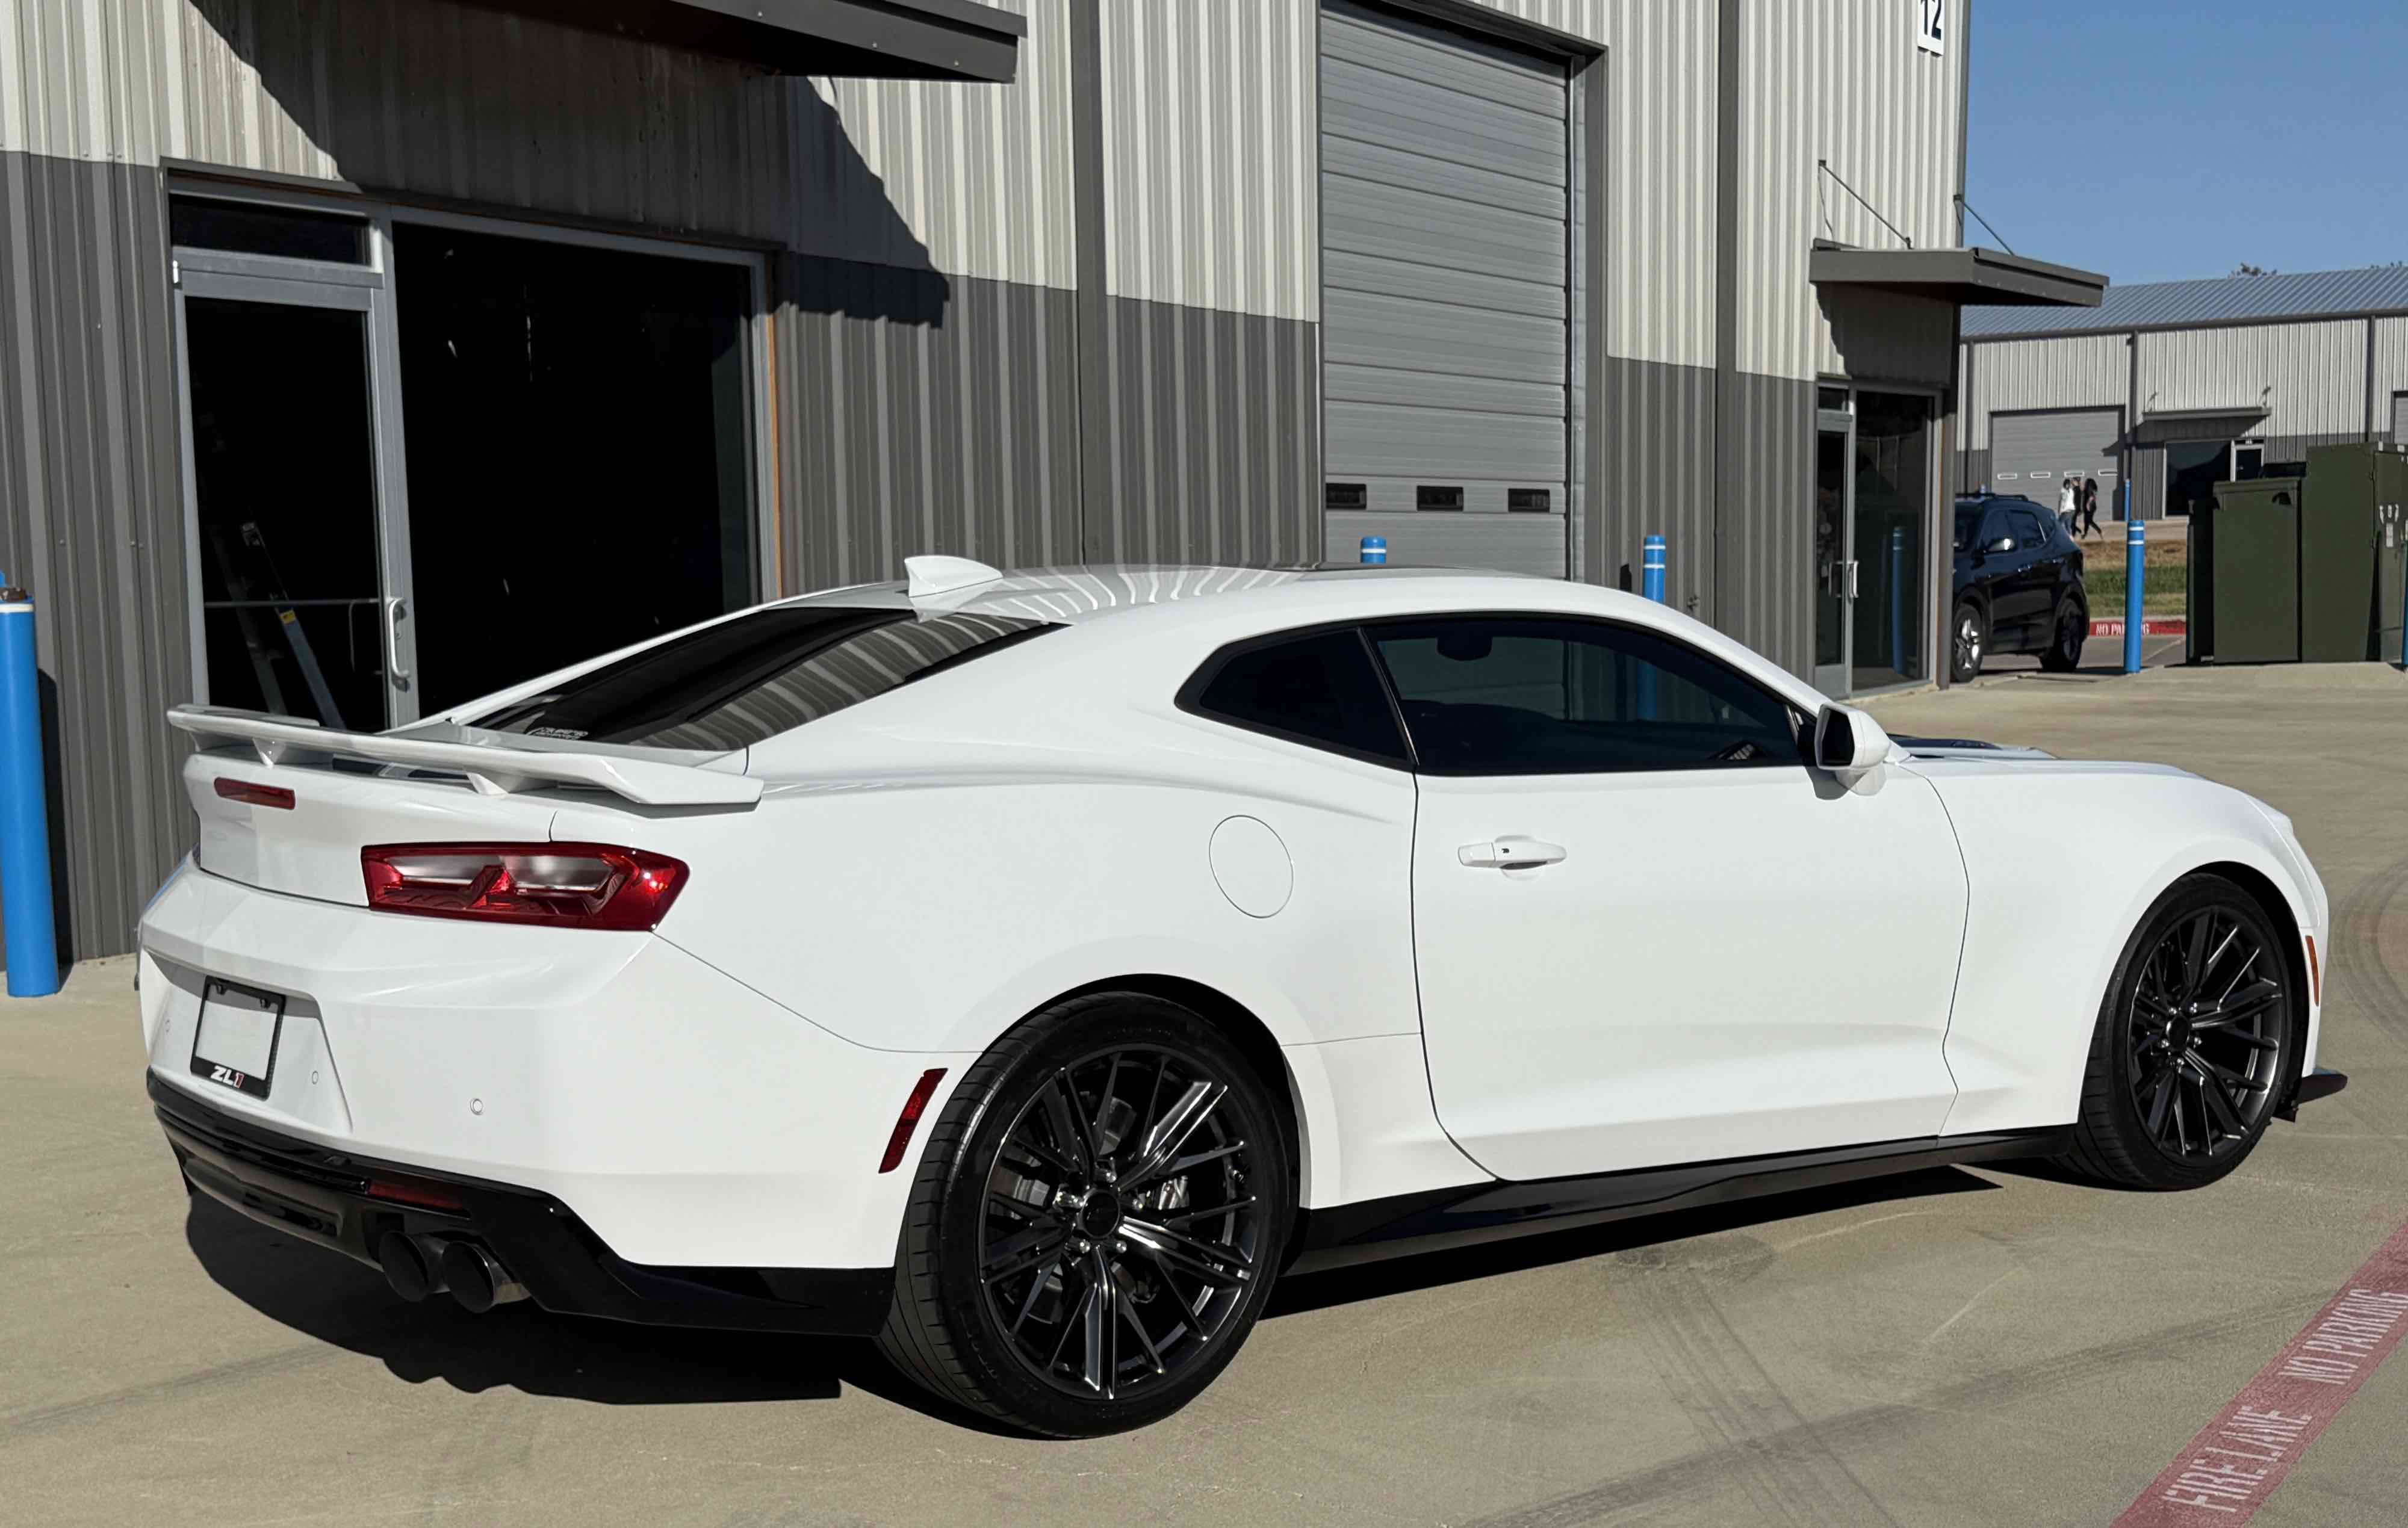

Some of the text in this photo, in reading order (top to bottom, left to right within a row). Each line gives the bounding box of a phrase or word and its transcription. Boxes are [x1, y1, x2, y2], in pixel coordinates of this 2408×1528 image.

[1920, 0, 1941, 40] 12
[2096, 623, 2108, 636] NO
[210, 1065, 244, 1089] ZL1
[2161, 1288, 2408, 1512] FIRE LANE NO PARKING
